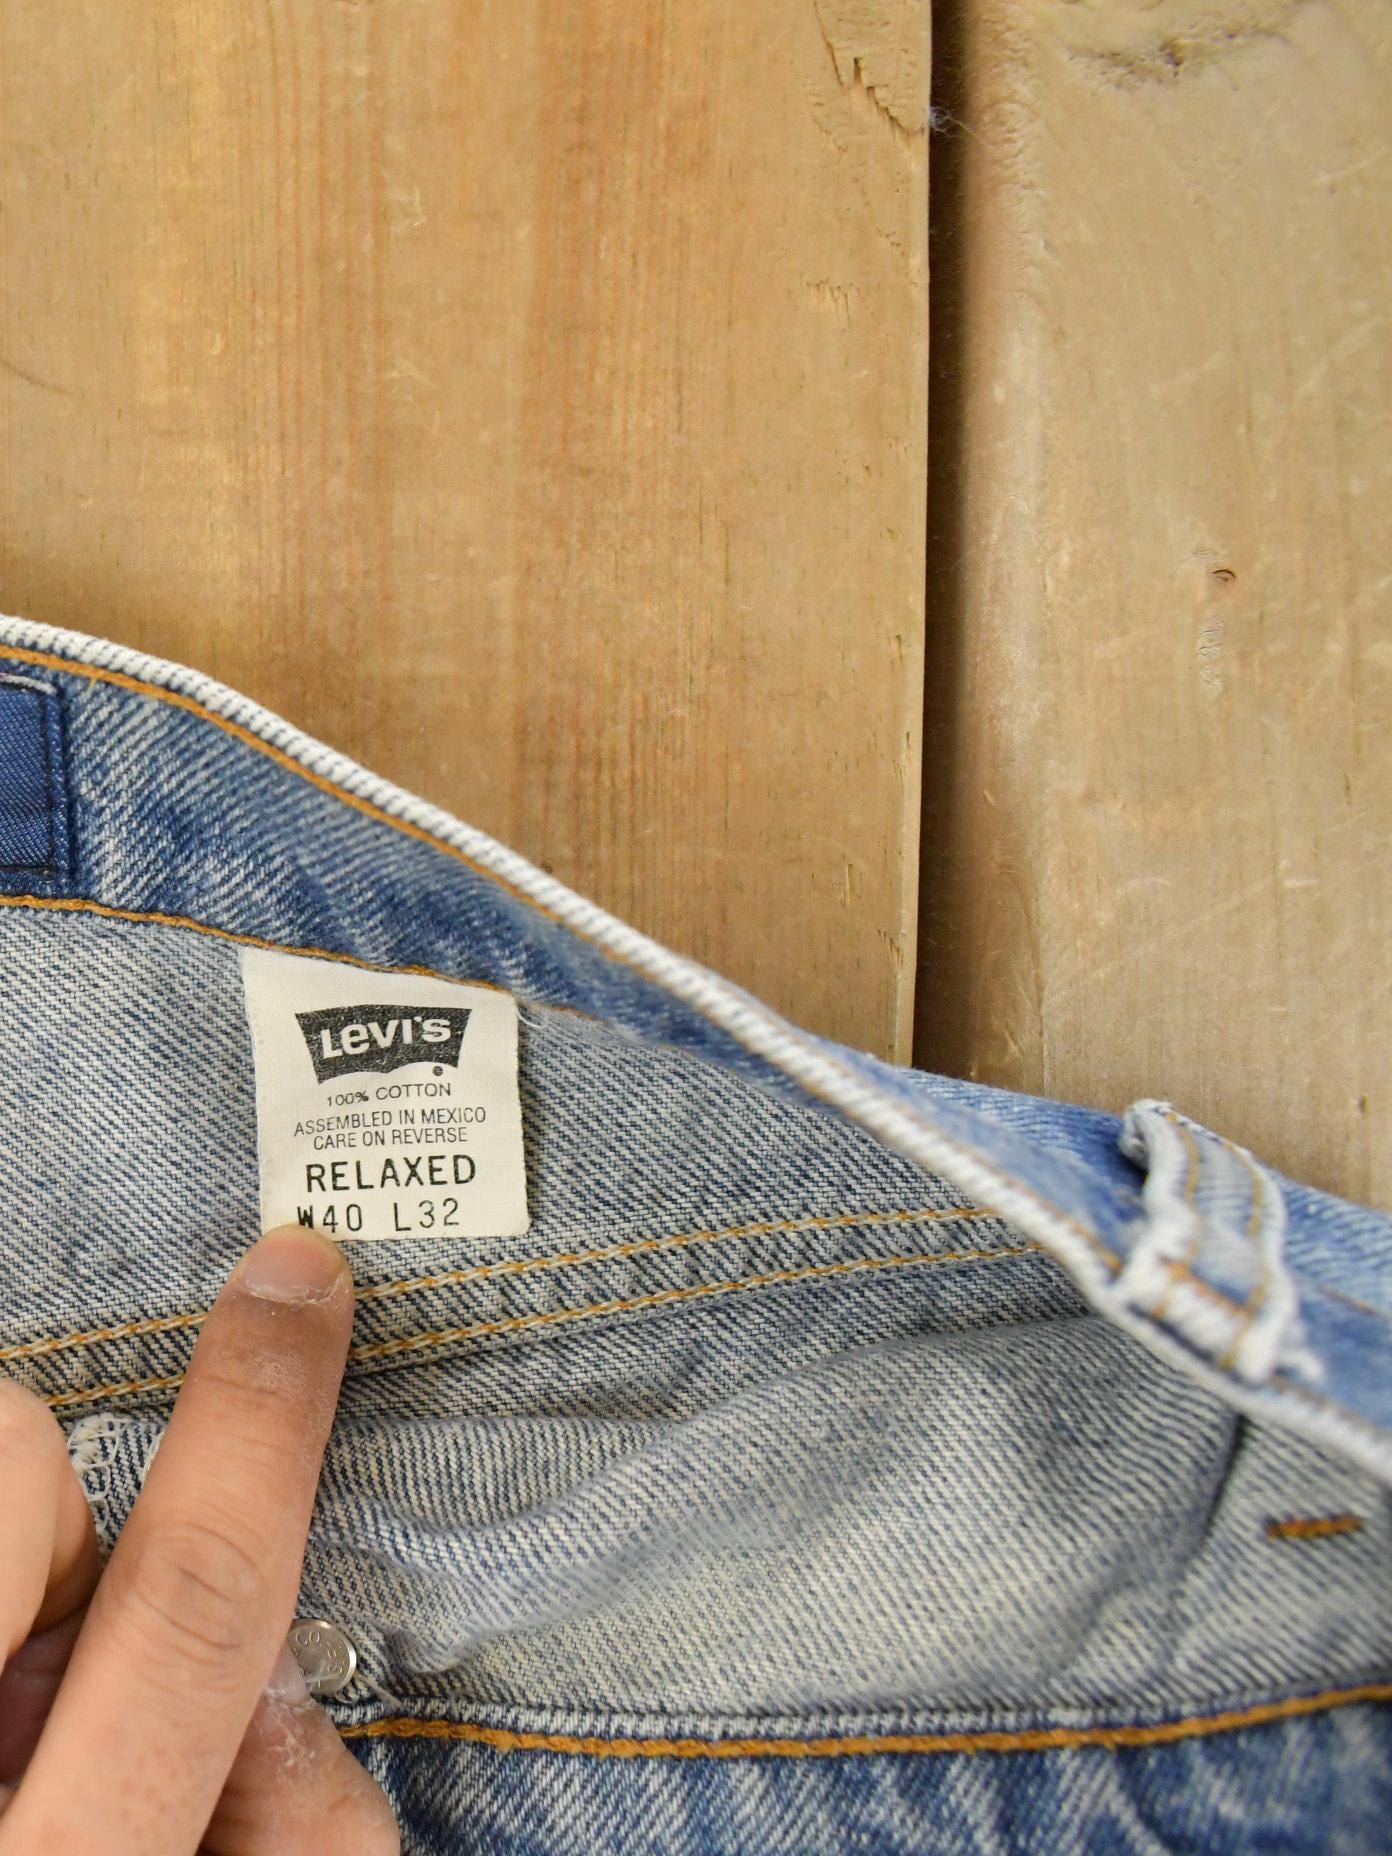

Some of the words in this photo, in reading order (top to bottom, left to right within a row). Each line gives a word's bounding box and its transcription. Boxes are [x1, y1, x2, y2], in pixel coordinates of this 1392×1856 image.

[318, 1015, 452, 1060] Levi's
[326, 1089, 370, 1107] 100%
[375, 1082, 452, 1101] COTTON
[293, 1110, 393, 1138] ASSEMBLED
[398, 1108, 415, 1126] IN
[421, 1106, 487, 1125] MEXICO
[313, 1132, 356, 1151] CARE
[362, 1129, 386, 1147] ON
[392, 1126, 468, 1145] REVERSE
[305, 1153, 477, 1193] RELAXED
[296, 1202, 364, 1234] W40
[393, 1197, 461, 1232] L32
